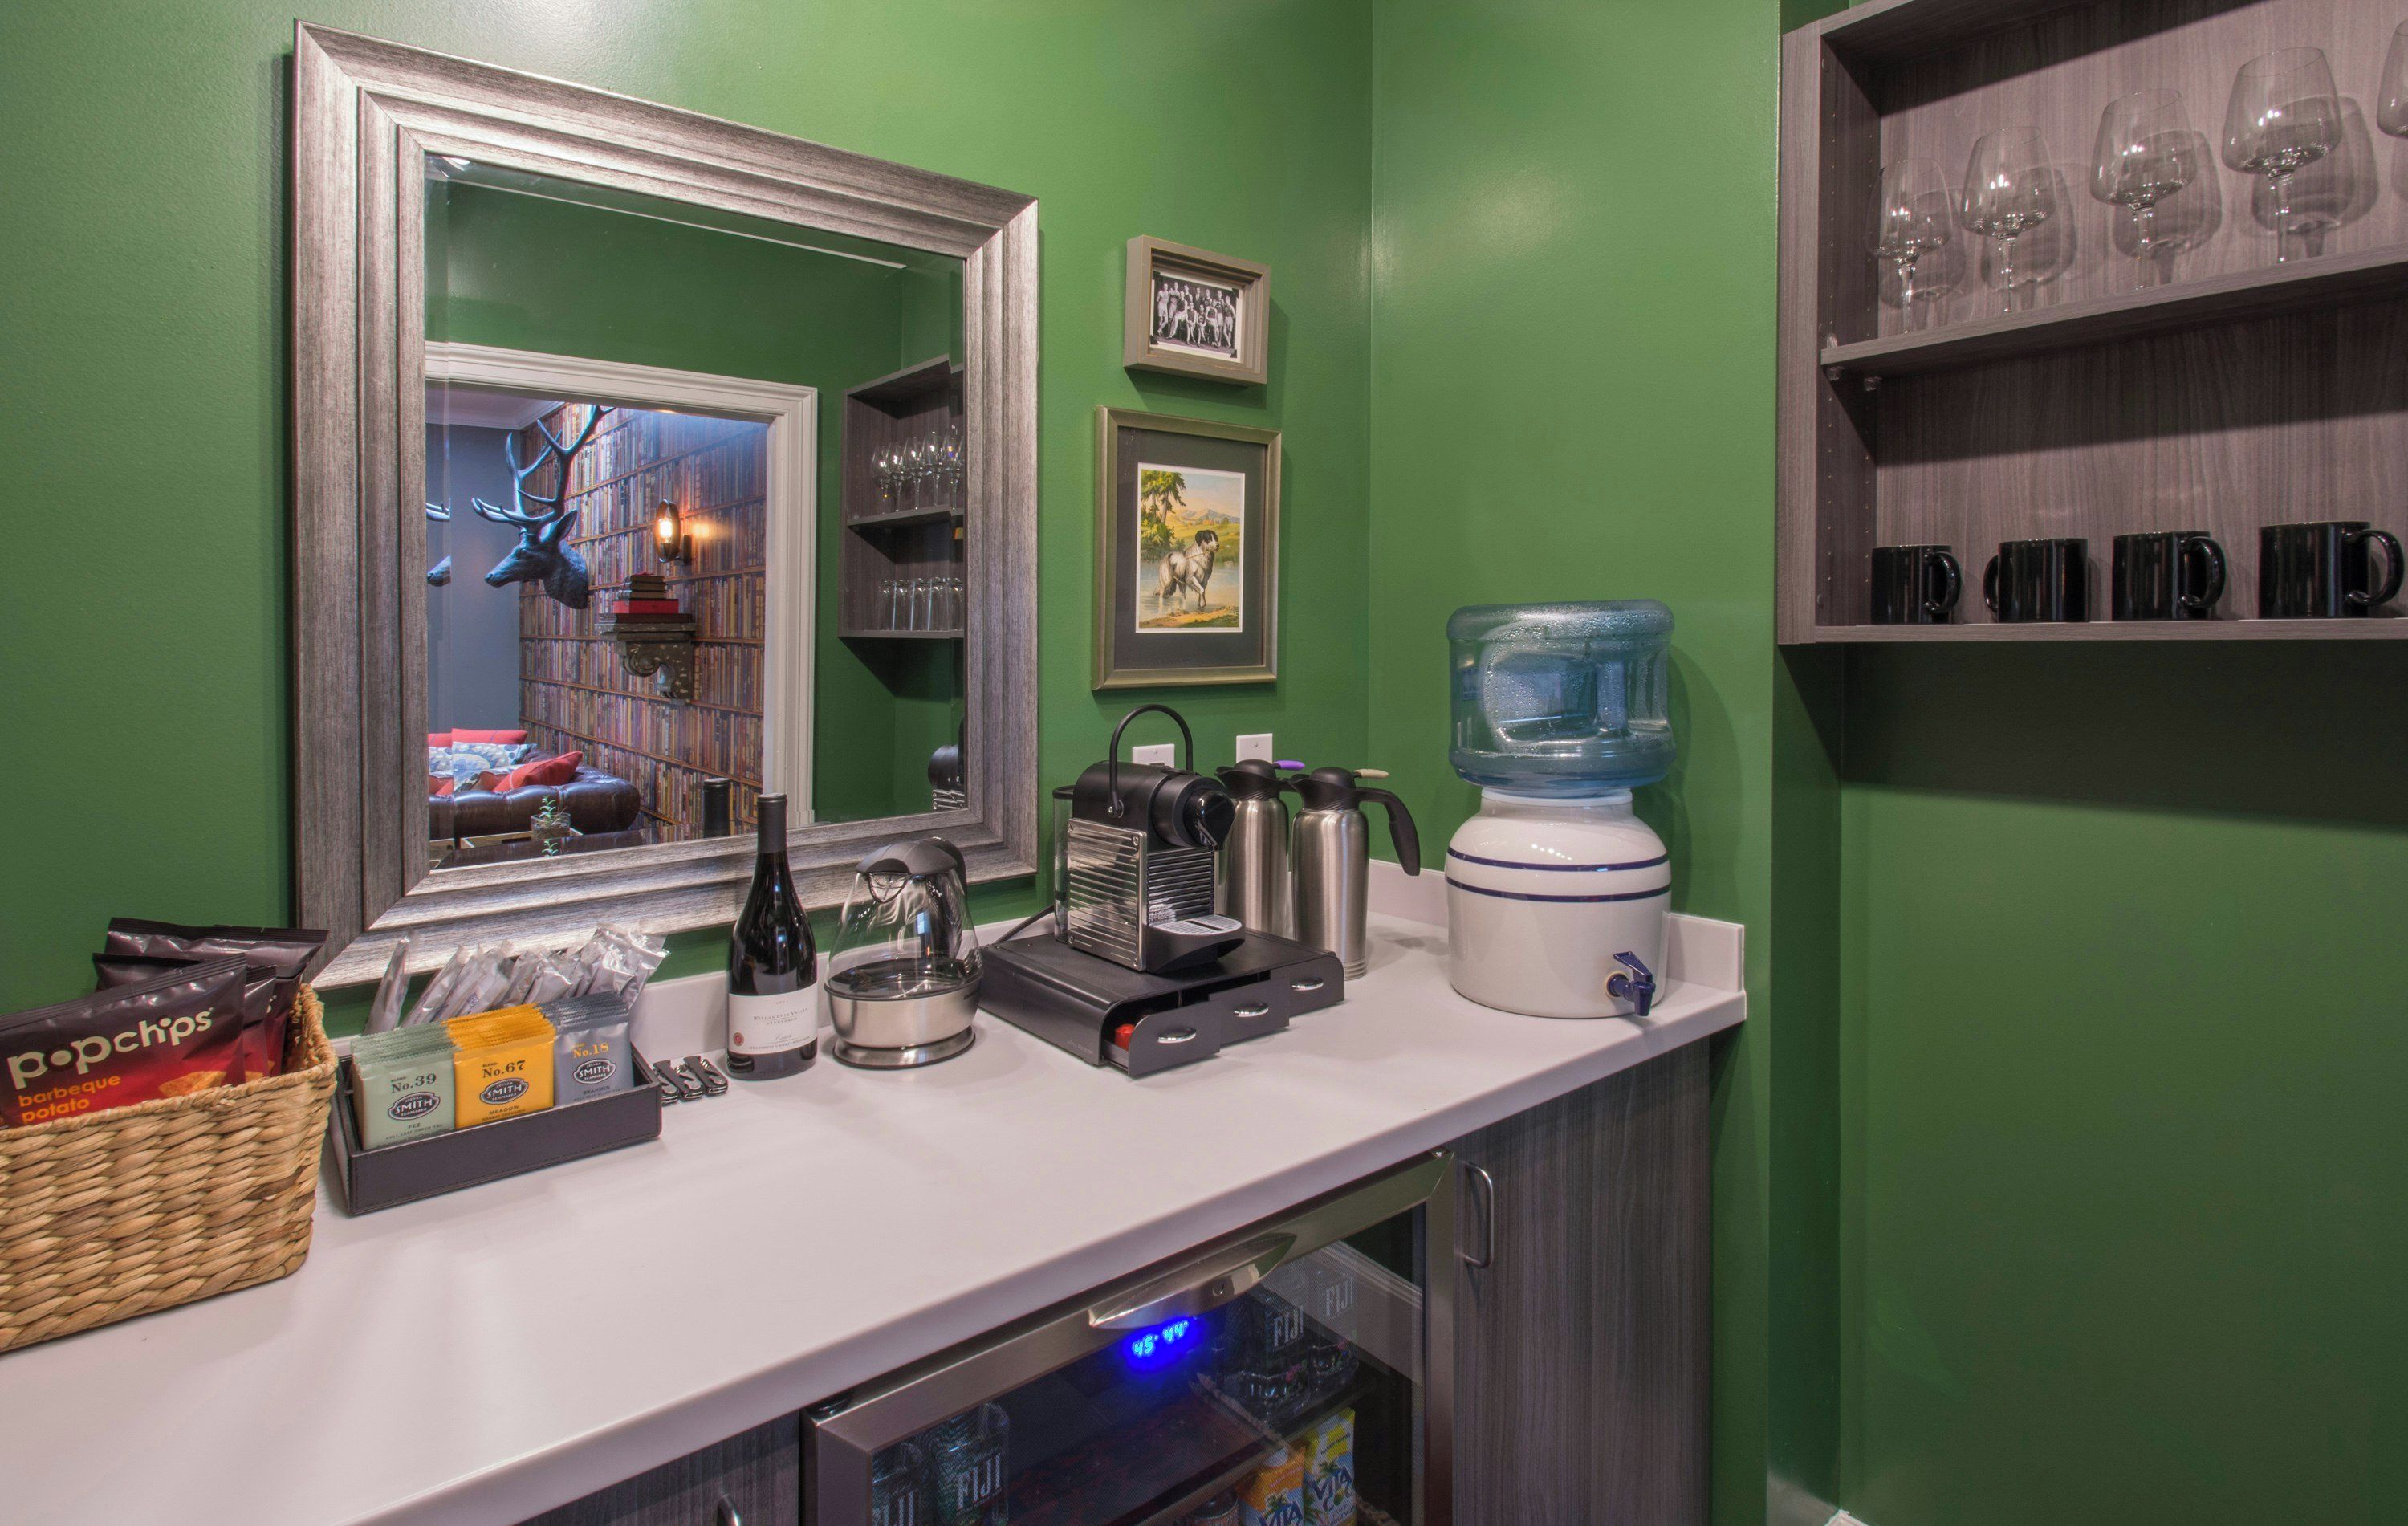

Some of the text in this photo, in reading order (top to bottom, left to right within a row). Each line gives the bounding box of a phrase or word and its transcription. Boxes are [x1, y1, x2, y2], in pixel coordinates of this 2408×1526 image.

[7, 1010, 213, 1090] popchips
[579, 1065, 611, 1079] SMITH
[18, 1076, 121, 1108] barbeque
[486, 1084, 523, 1099] SMITH
[21, 1097, 90, 1124] potato
[395, 1099, 433, 1115] SMITH
[489, 1105, 520, 1115] MEADOW
[407, 1122, 421, 1130] FEZ
[1324, 1276, 1354, 1316] FIJI
[1272, 1304, 1304, 1349] FIJI
[957, 1454, 1001, 1510] FIJI
